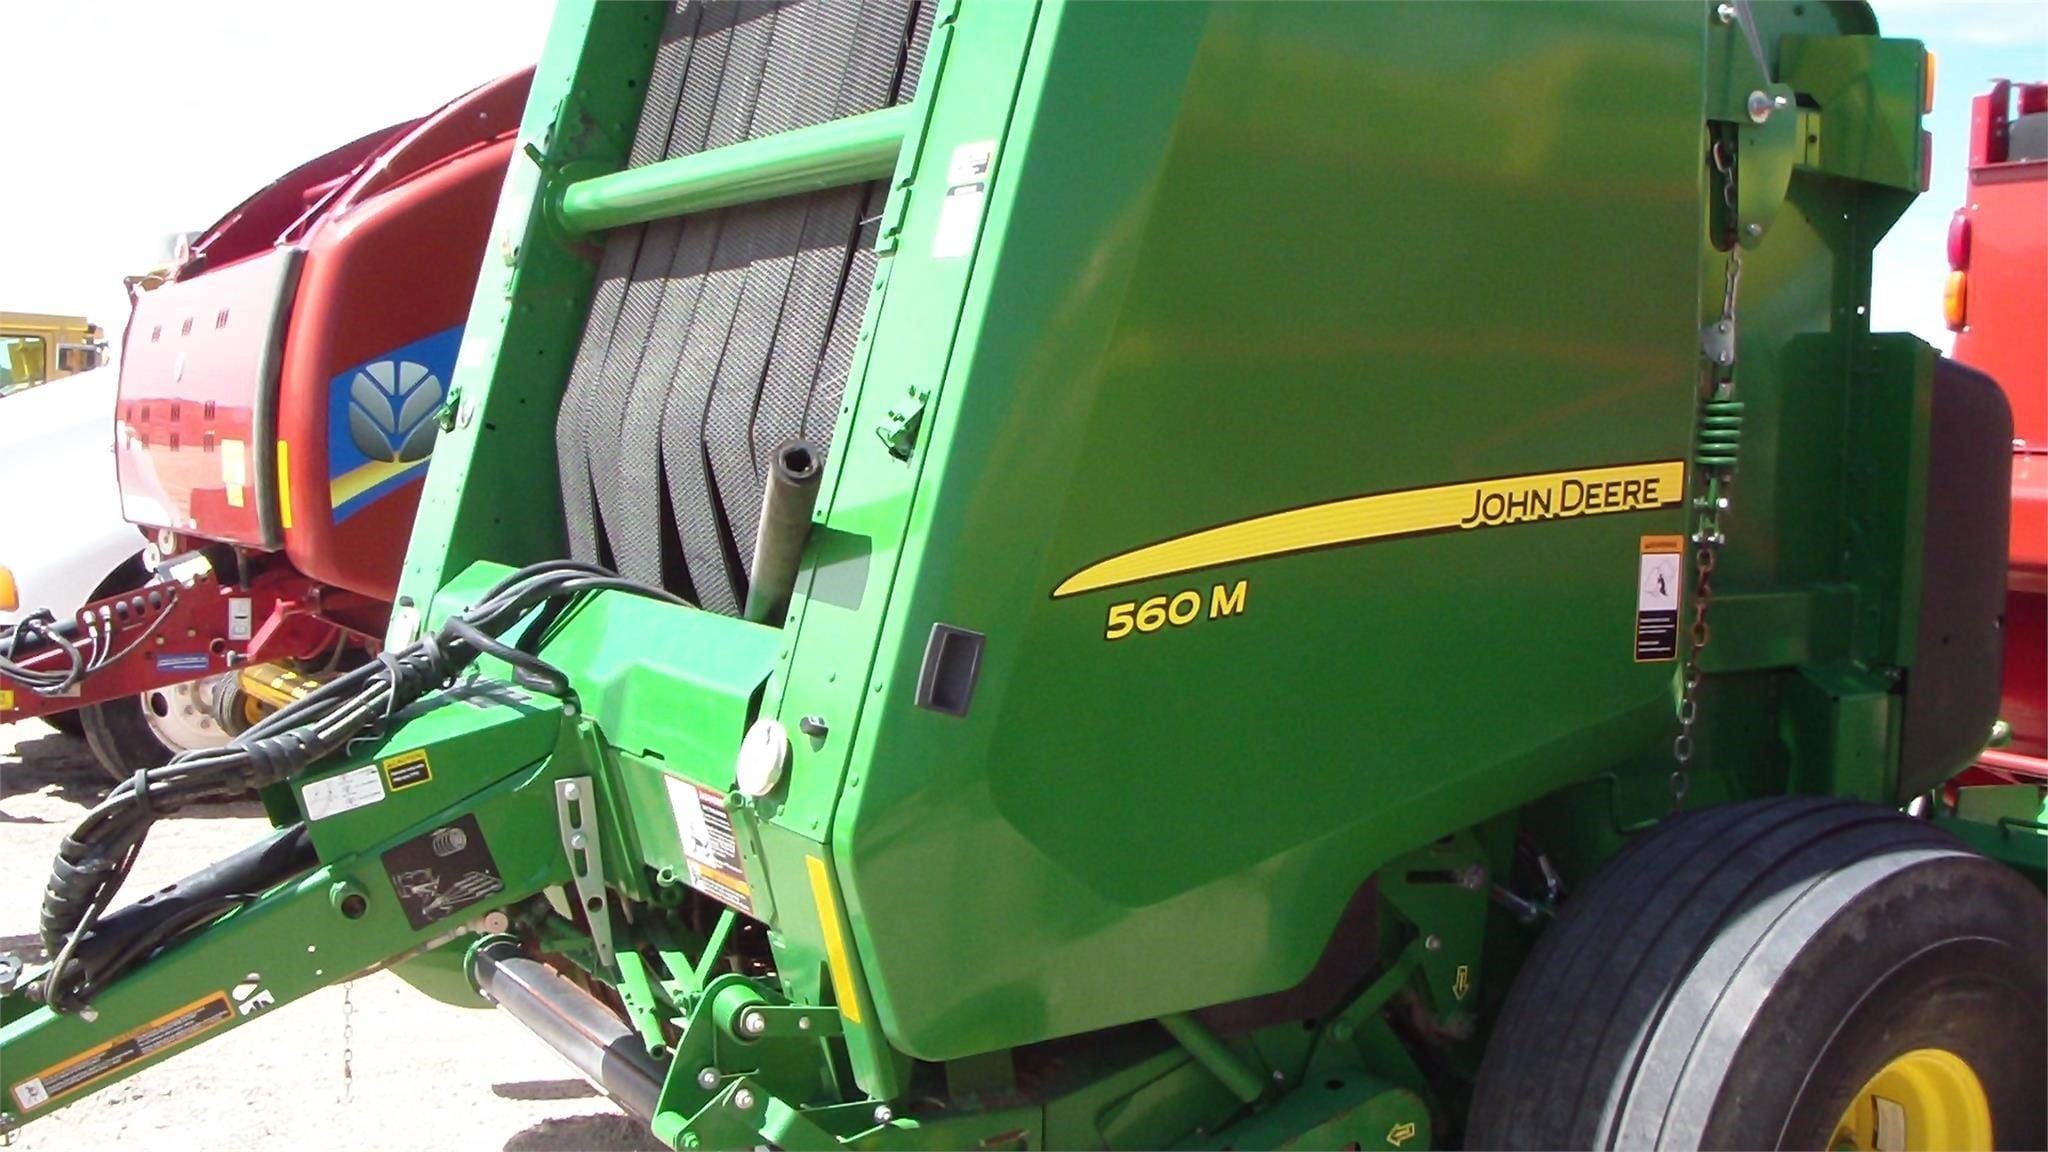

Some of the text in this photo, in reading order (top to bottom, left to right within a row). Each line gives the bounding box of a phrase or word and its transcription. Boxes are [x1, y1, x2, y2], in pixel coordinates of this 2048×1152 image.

[1461, 477, 1661, 524] JOHN DEERE
[1105, 580, 1248, 640] 560 M
